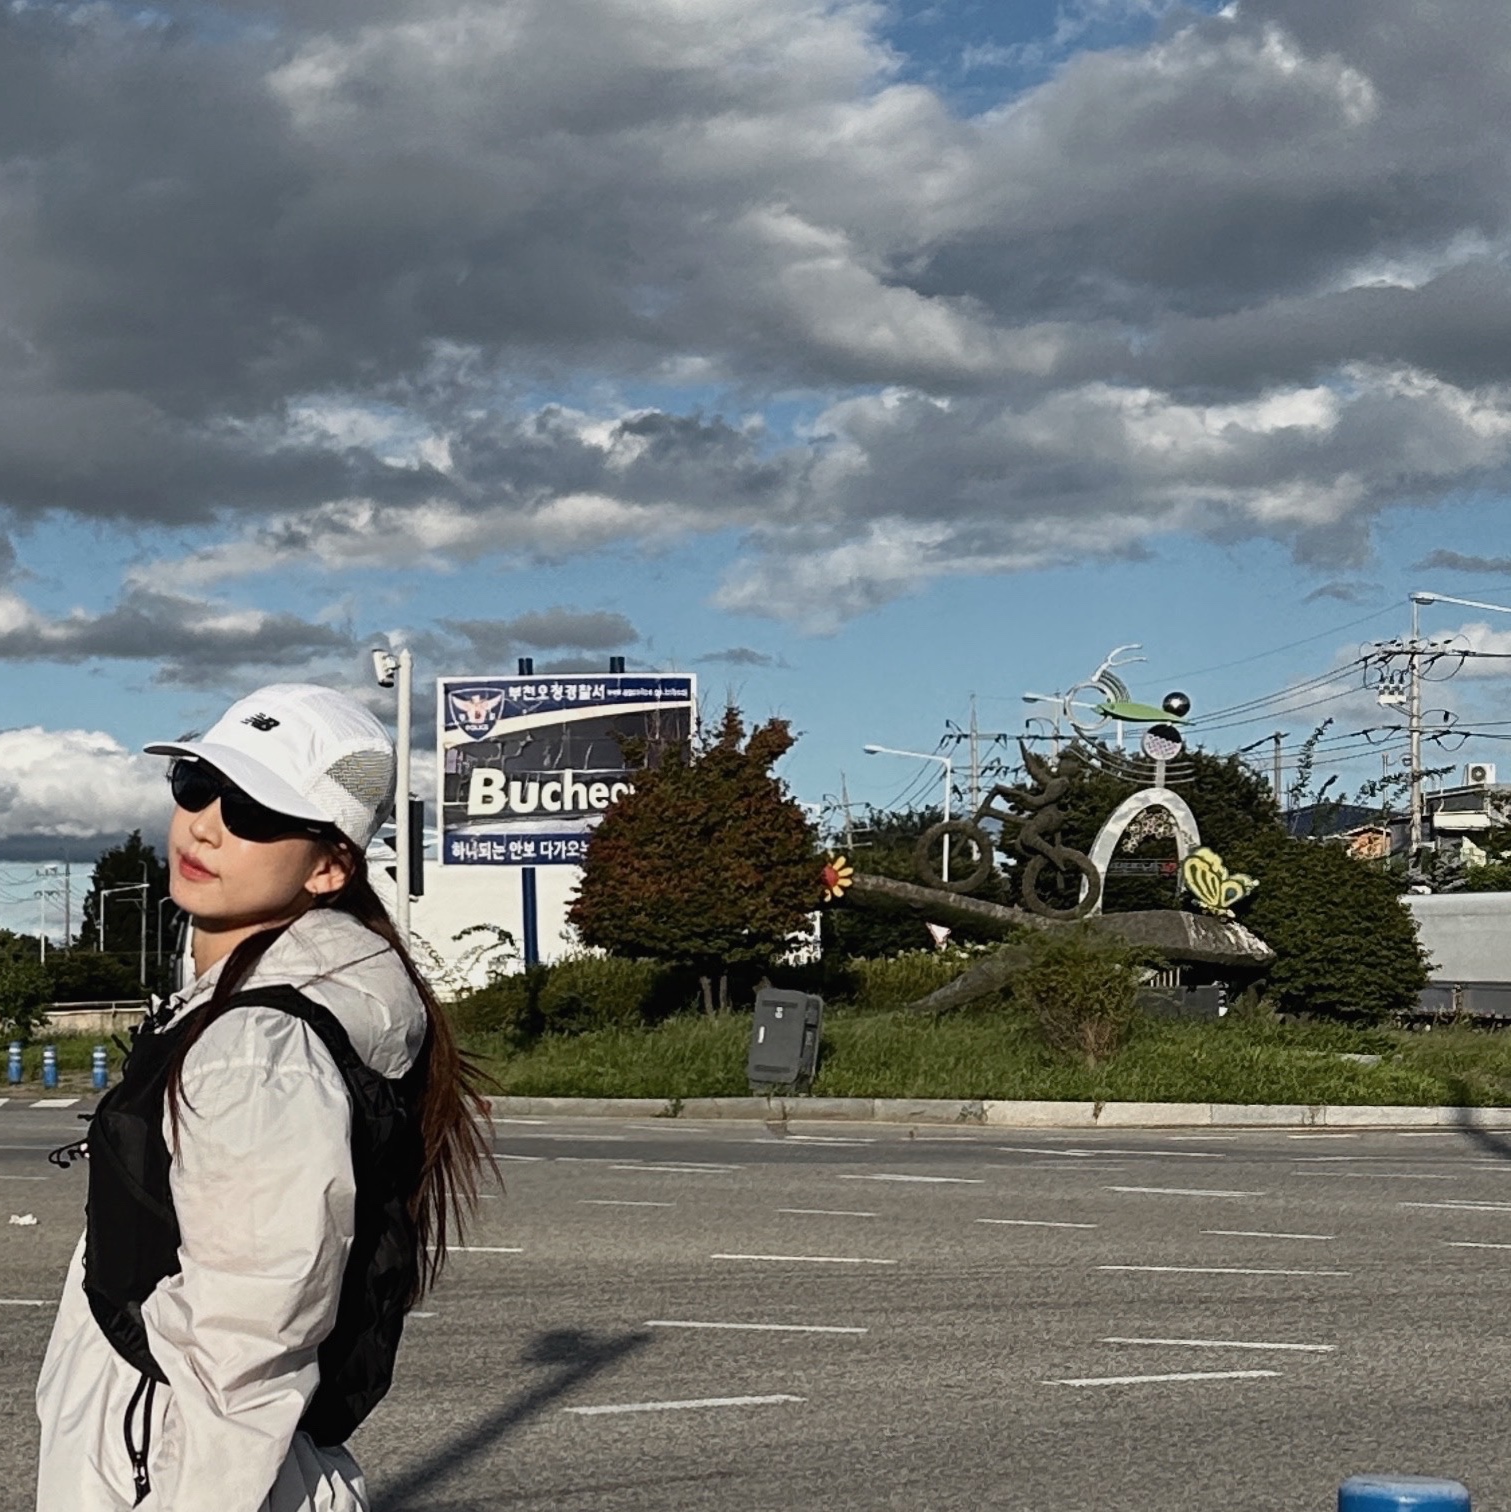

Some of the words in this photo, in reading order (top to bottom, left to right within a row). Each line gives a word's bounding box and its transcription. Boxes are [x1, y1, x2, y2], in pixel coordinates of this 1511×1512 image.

[508, 684, 606, 701] 부천오정경찰서
[468, 768, 636, 815] Bucheo
[451, 840, 506, 861] 하나되는
[509, 840, 537, 860] 안보
